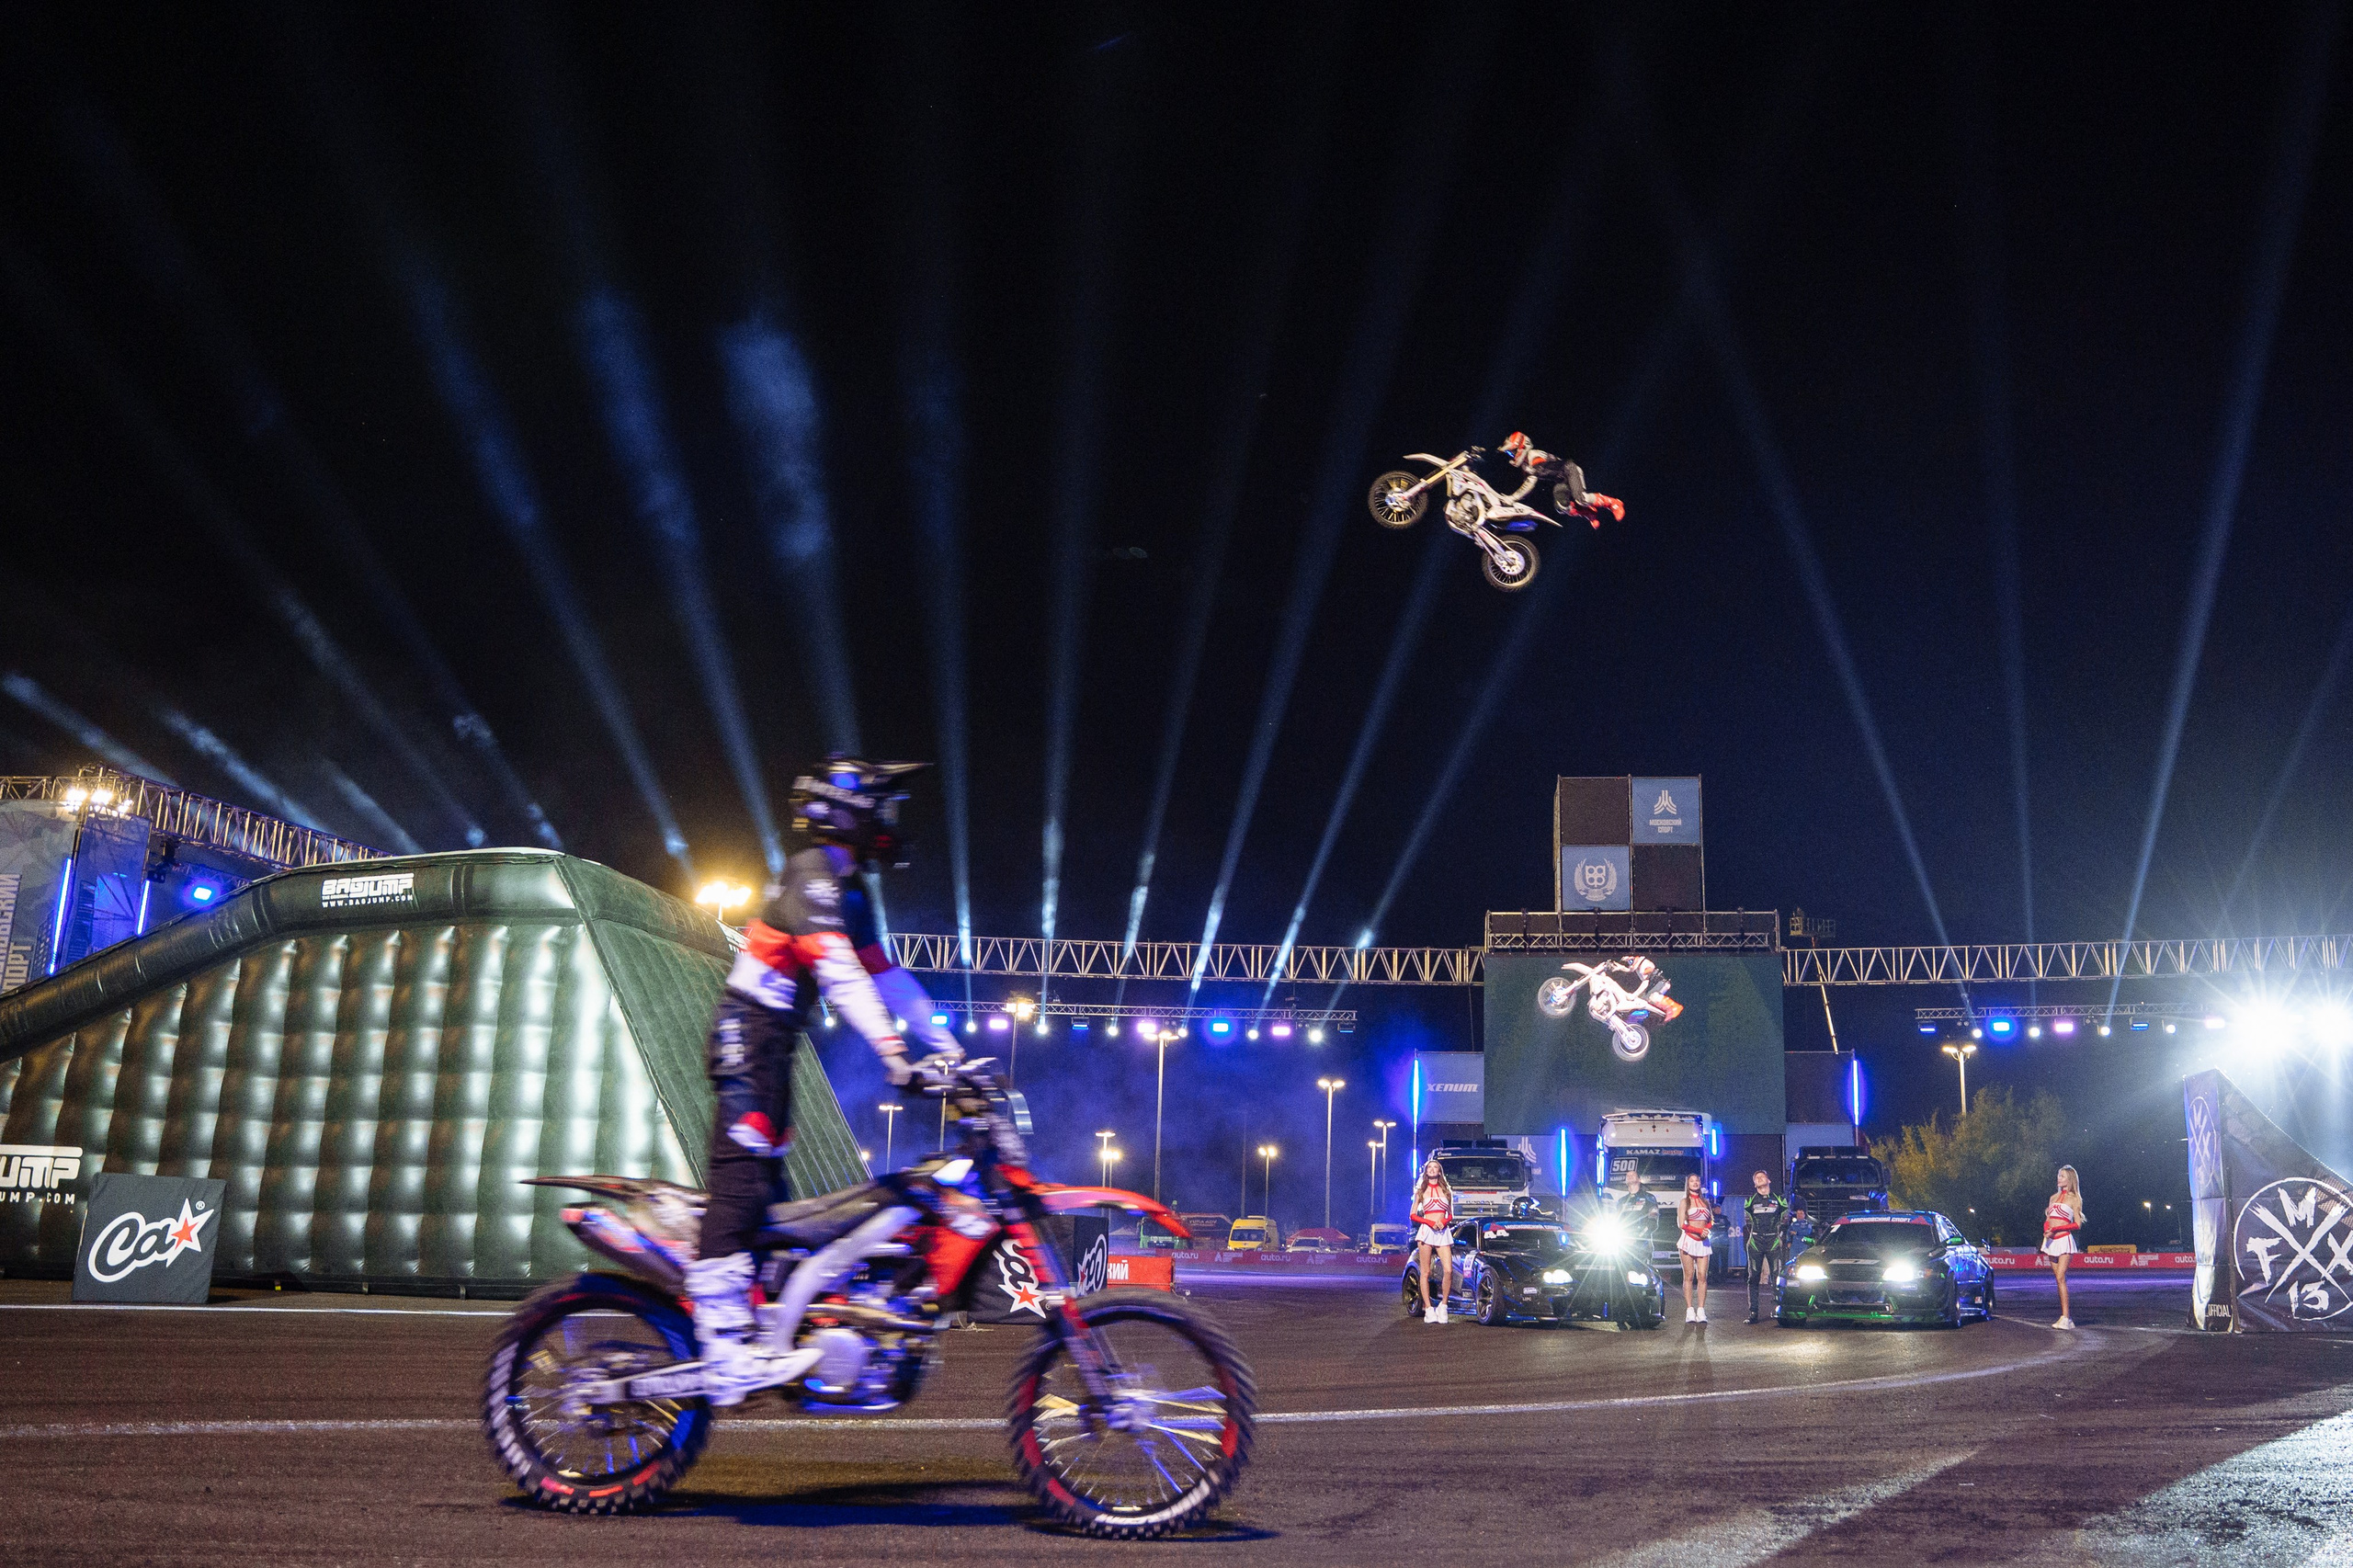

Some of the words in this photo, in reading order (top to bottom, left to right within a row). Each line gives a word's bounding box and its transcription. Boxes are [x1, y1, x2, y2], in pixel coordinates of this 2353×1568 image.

[322, 873, 415, 898] BAGJUMP
[322, 894, 414, 908] WWW.BAGJUMP.COM
[2, 941, 32, 994] ПОРТ
[1426, 1083, 1479, 1092] XENUM
[0, 1144, 83, 1188] UMP
[1612, 1159, 1636, 1172] 500
[0, 1192, 75, 1205] UMP.COM
[1171, 1251, 1199, 1259] auto.ru
[1260, 1254, 1291, 1262] auto.ru
[1356, 1255, 1388, 1264] auto.ru
[2084, 1256, 2114, 1264] auto.ru
[2175, 1256, 2196, 1264] auto.
[1107, 1260, 1130, 1280] КИЙ
